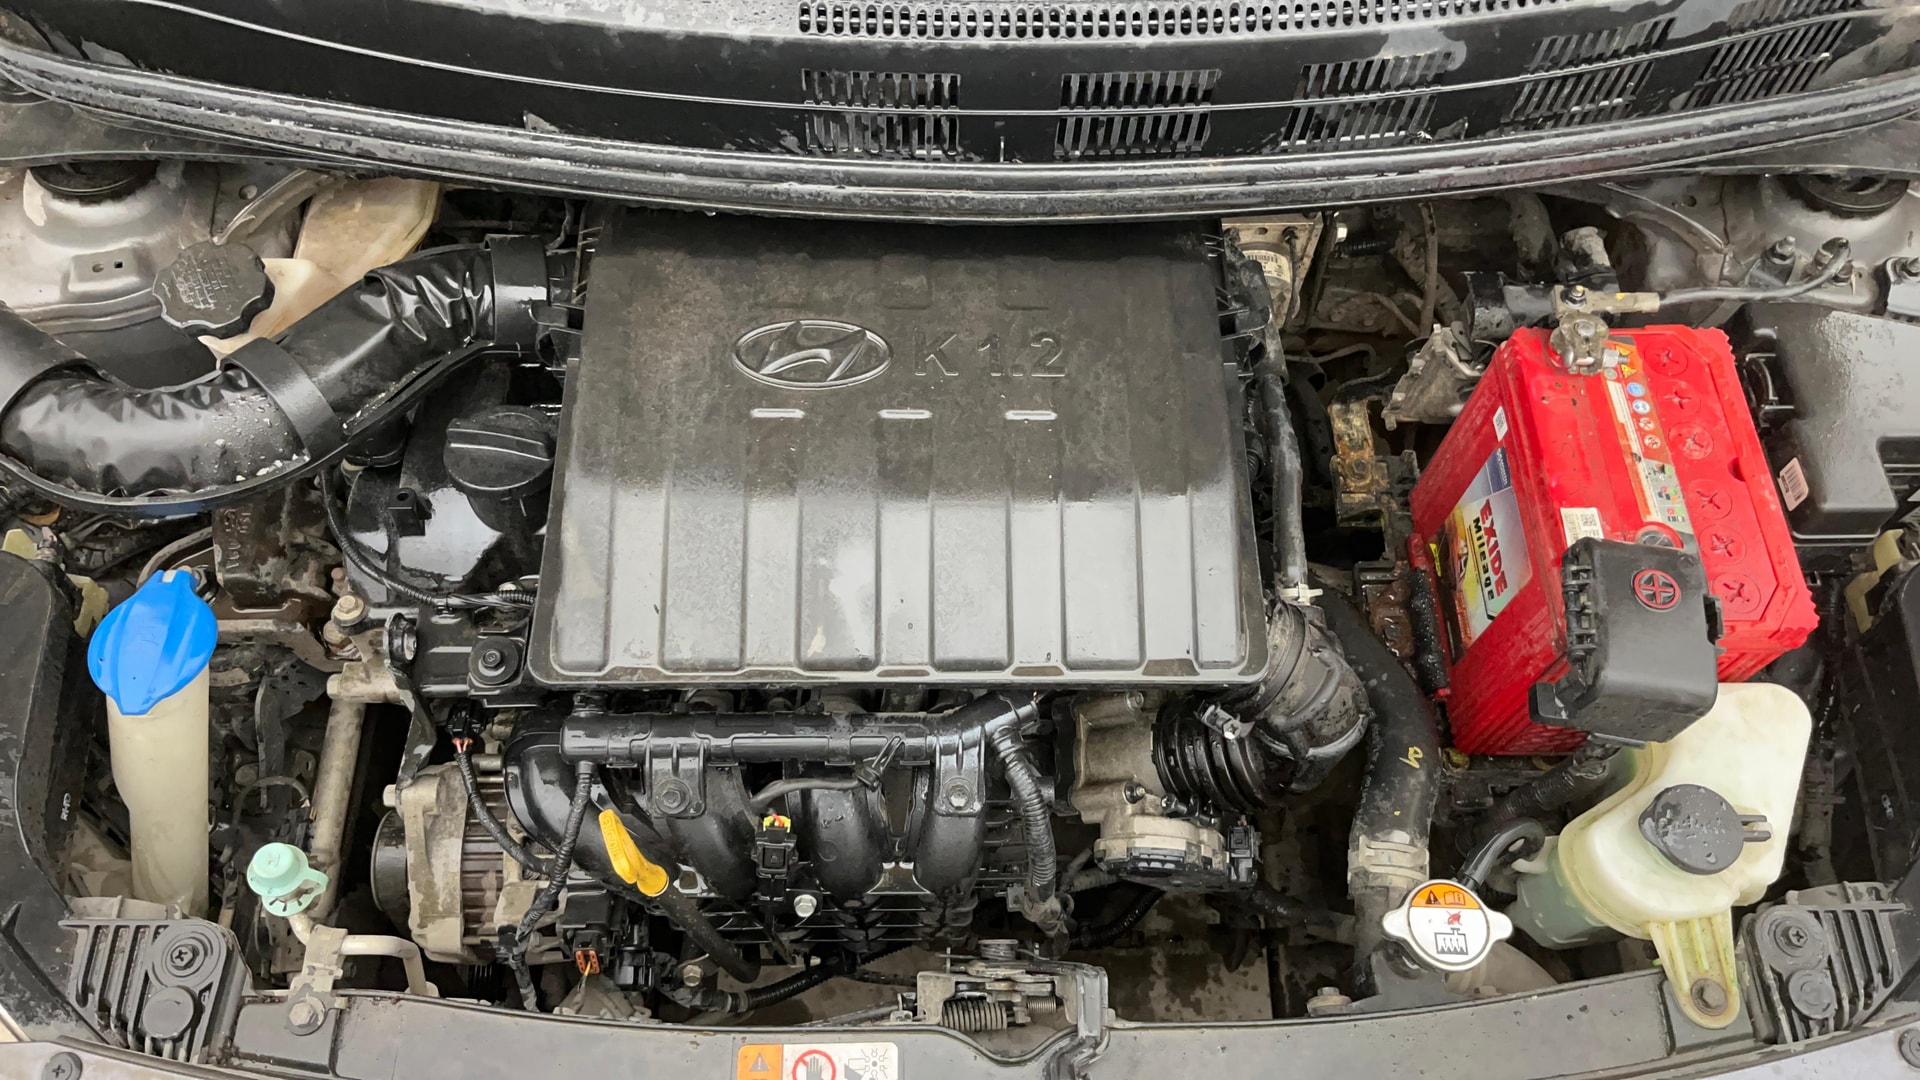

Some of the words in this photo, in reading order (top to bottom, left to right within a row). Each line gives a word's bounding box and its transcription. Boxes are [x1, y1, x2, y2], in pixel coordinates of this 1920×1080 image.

[913, 330, 959, 376] K
[977, 331, 1066, 377] 1.2
[1472, 516, 1495, 600] Mileage
[1479, 498, 1508, 597] EXIDE
